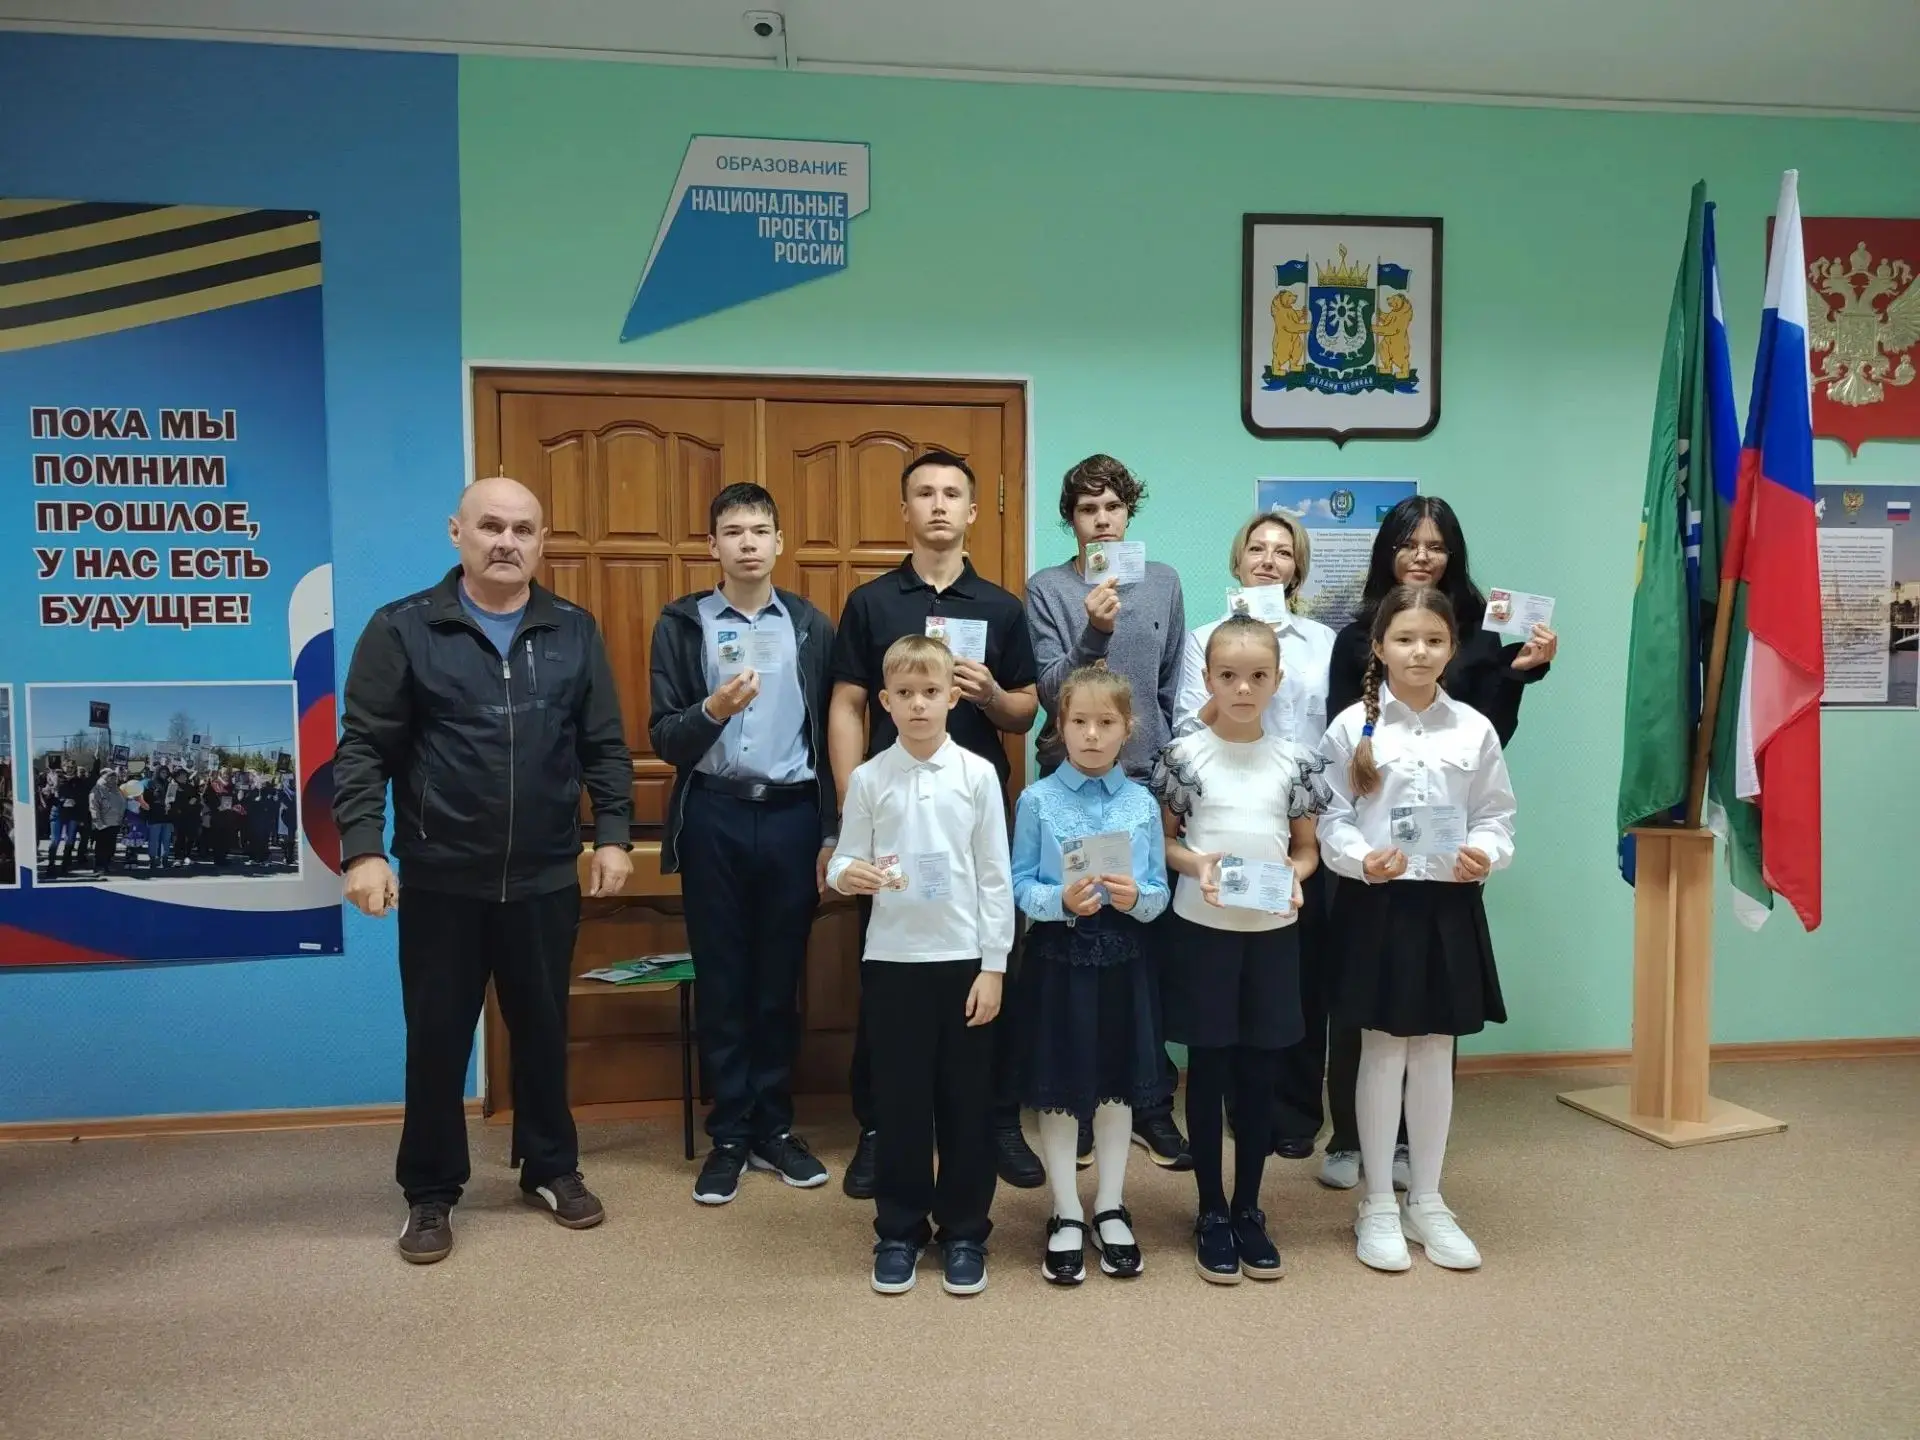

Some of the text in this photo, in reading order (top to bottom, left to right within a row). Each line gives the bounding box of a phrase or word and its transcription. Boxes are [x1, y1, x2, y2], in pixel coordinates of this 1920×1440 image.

[716, 155, 848, 176] ОБРАЗОВАНИЕ
[691, 189, 845, 218] НАЦИОНАЛЬНЫЕ
[758, 217, 845, 242] ПРОЕКТЫ
[774, 241, 845, 266] РОССИИ
[31, 406, 237, 441] ПОКА МЫ
[33, 454, 227, 488] ПОМНИМ
[35, 500, 260, 539] ПРОШЛОЕ,
[34, 547, 270, 580] У НАС ЕСТЬ
[40, 593, 251, 630] БУДУЩЕЕ!
